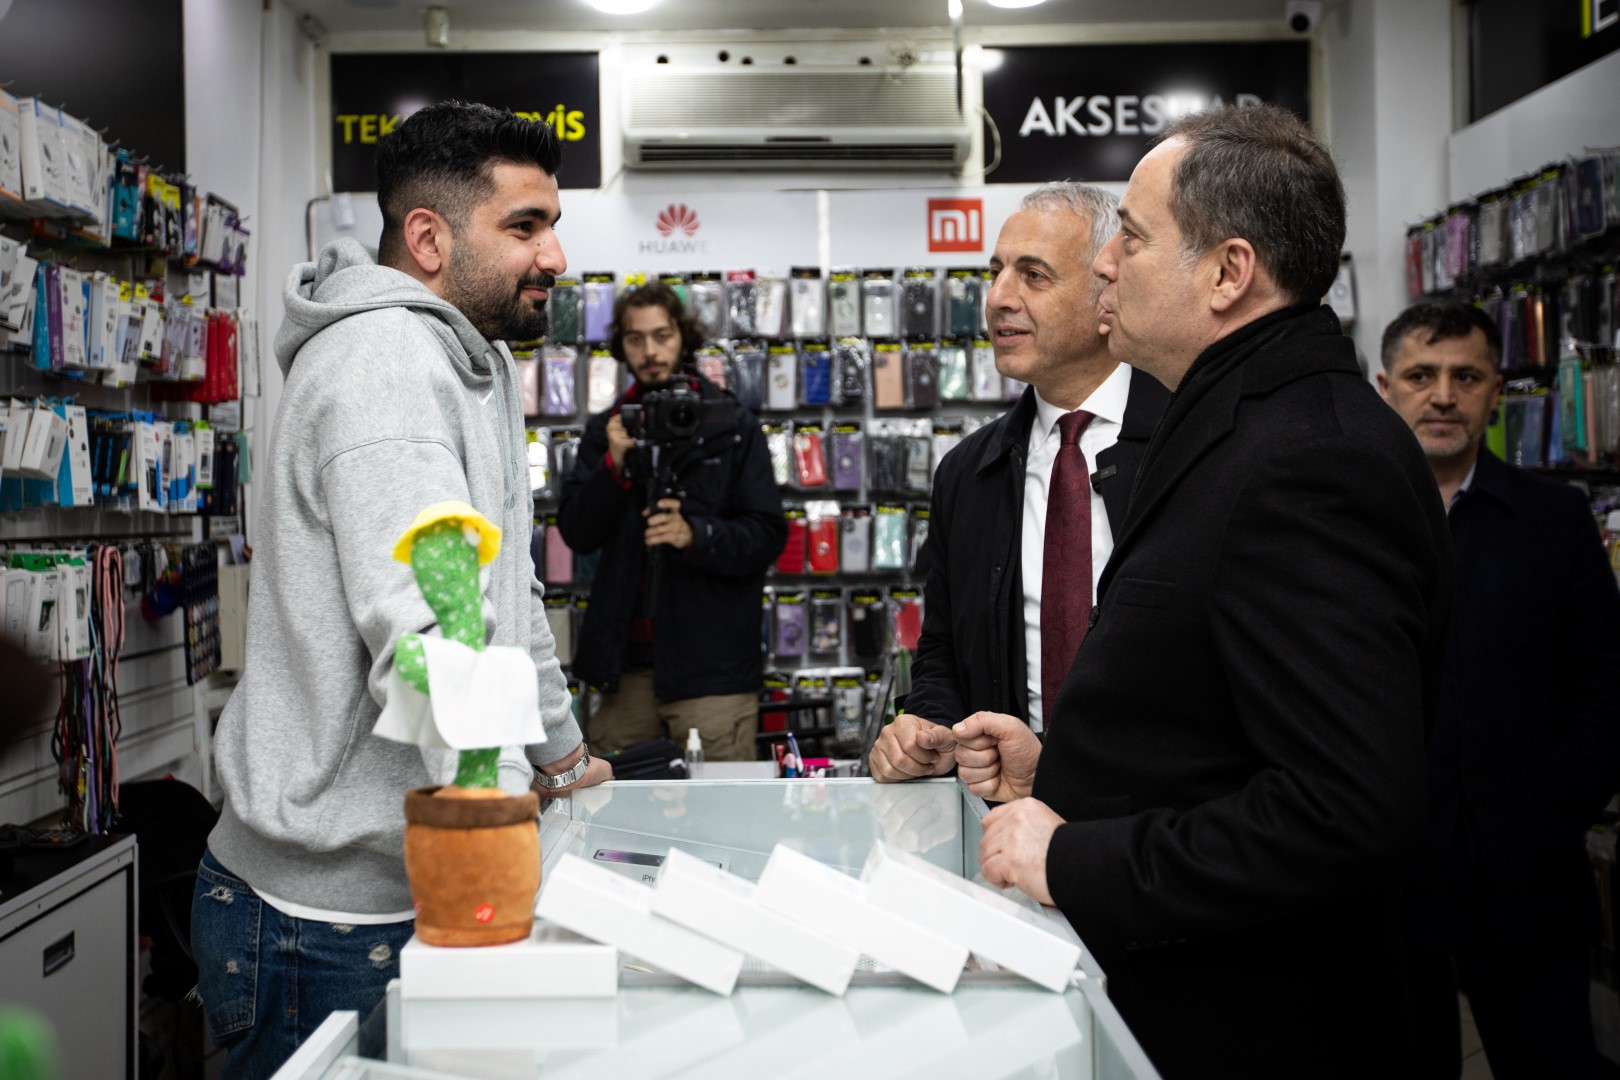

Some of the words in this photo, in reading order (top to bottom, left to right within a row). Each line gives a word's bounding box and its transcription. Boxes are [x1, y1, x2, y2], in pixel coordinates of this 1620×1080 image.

[336, 113, 409, 145] TEK
[638, 240, 712, 254] HUAWE
[641, 873, 657, 883] iPh
